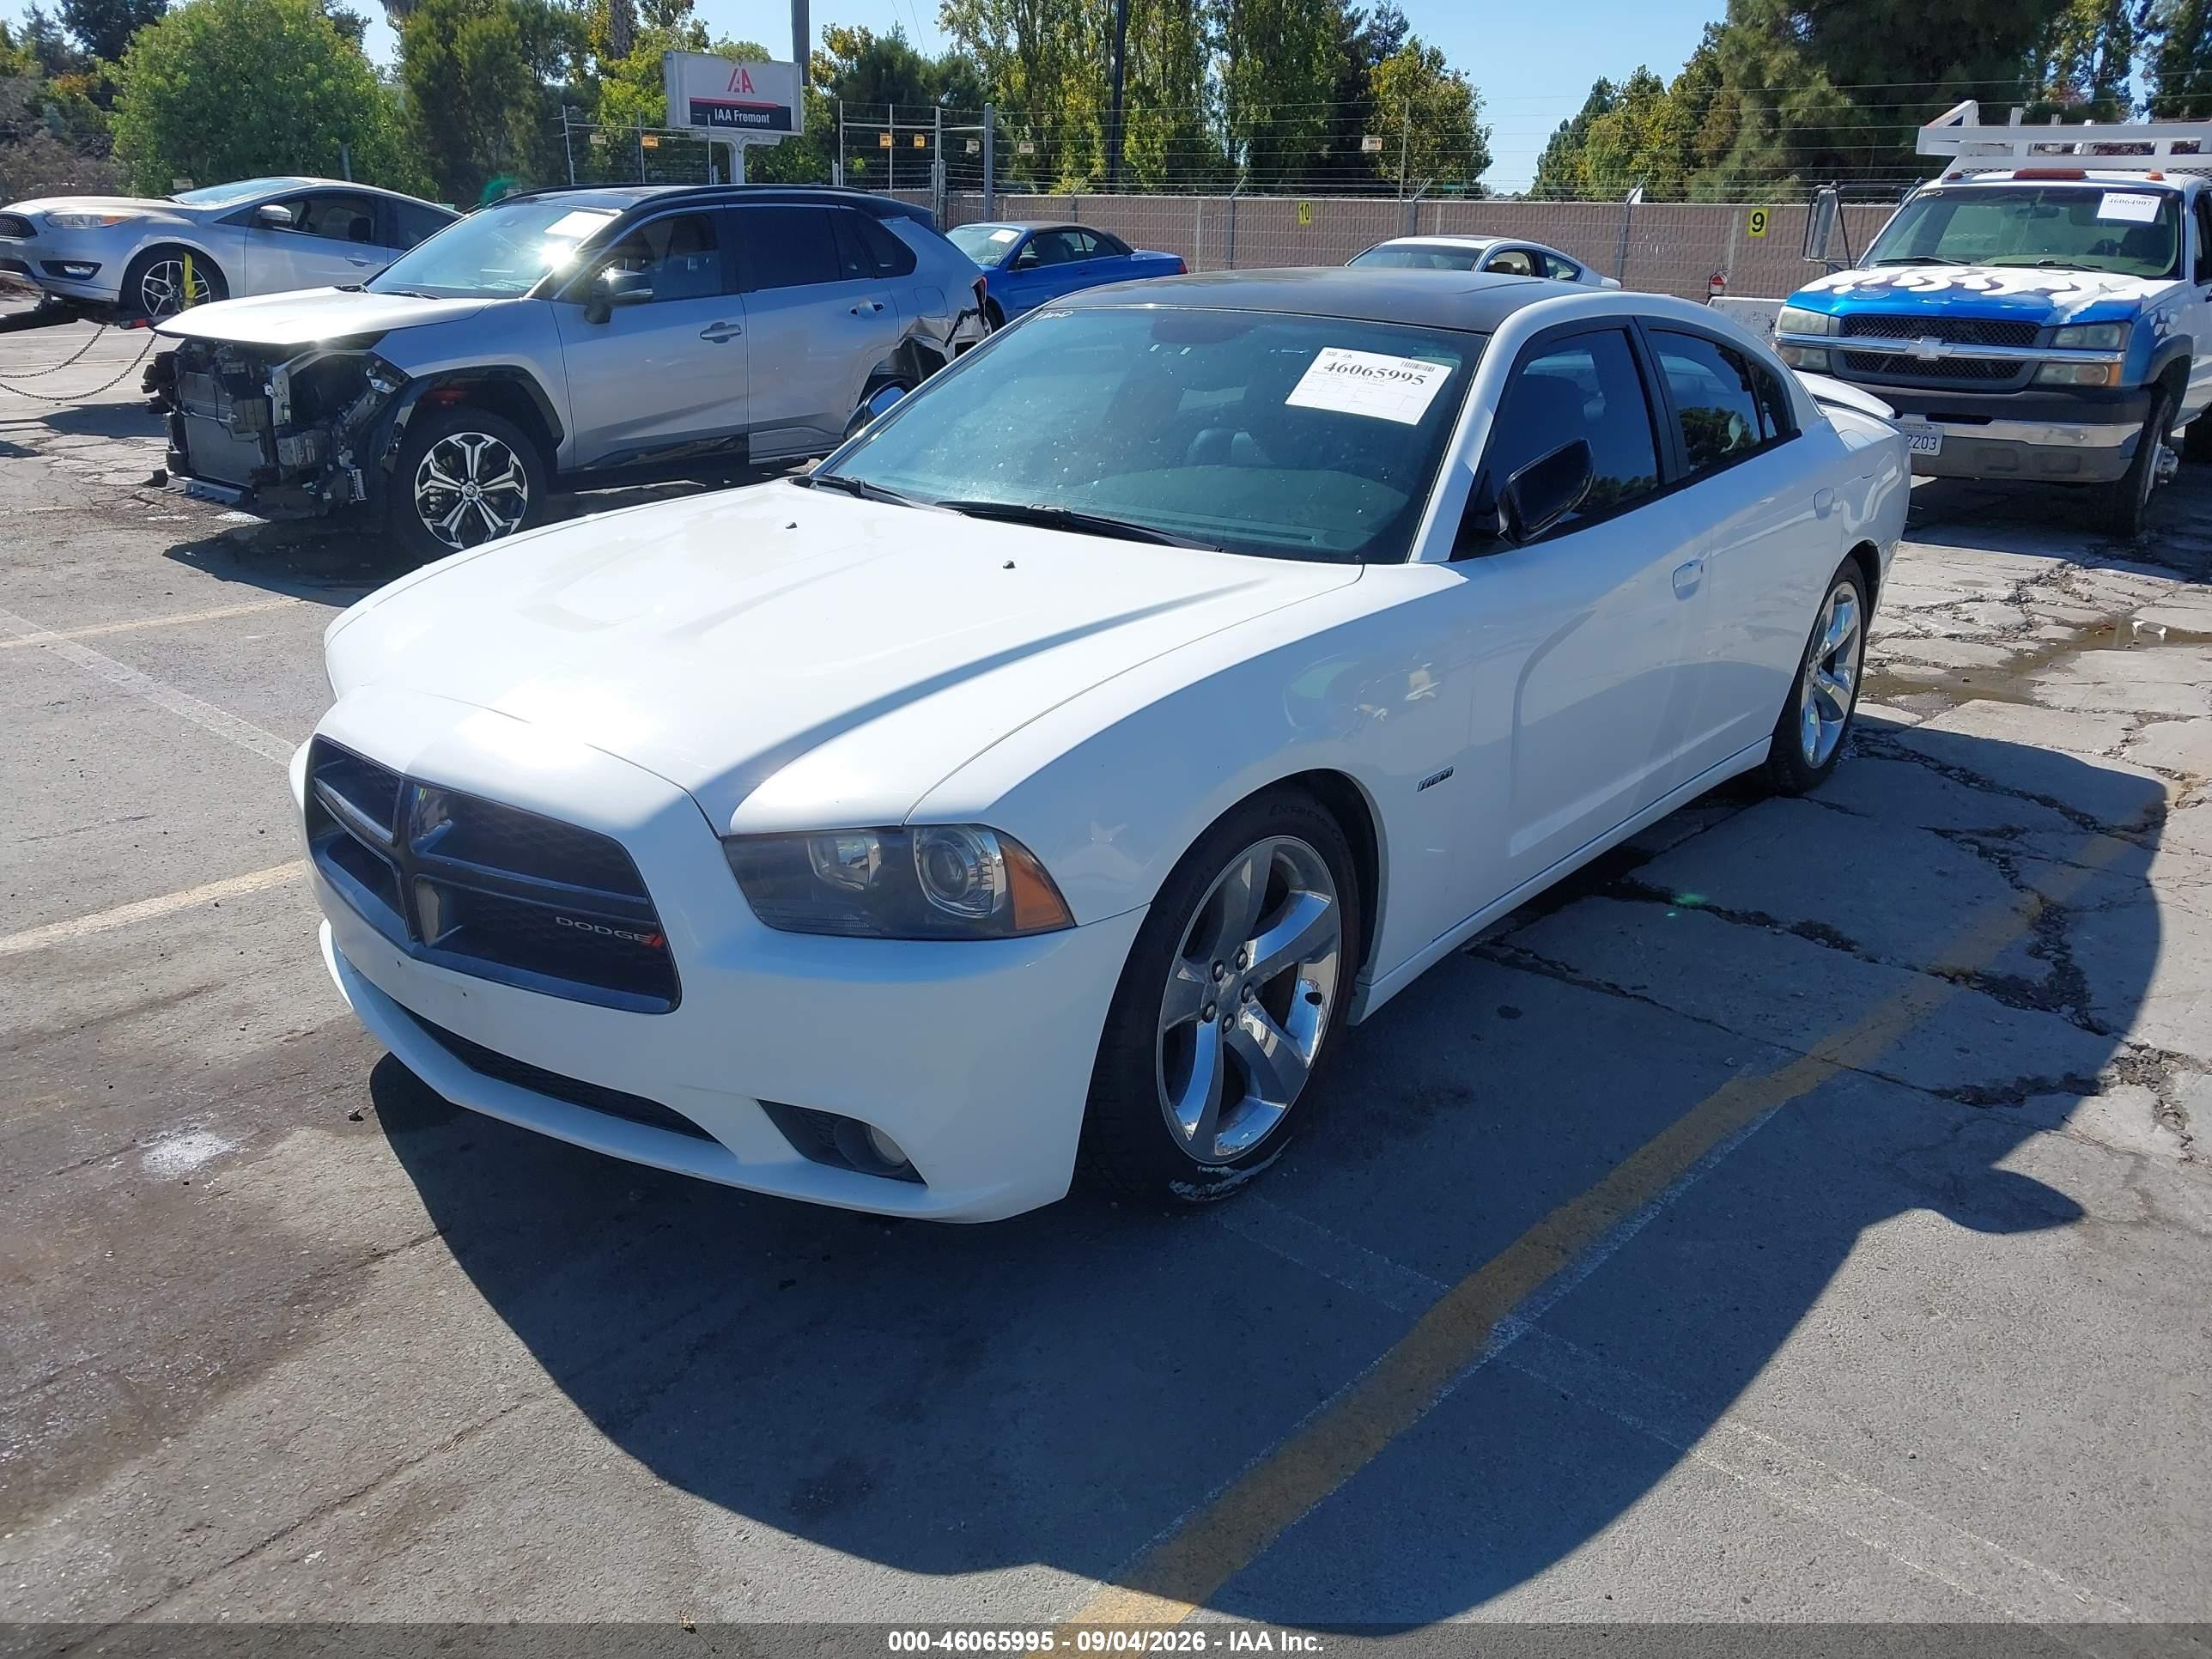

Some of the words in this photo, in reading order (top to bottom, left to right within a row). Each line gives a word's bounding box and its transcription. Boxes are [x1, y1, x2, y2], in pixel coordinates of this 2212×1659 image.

[714, 108, 732, 121] IAA
[734, 109, 770, 124] Fremont
[1300, 202, 1310, 221] 10
[1752, 211, 1765, 233] 9
[1323, 360, 1429, 386] 46065995
[556, 916, 653, 944] DODGE
